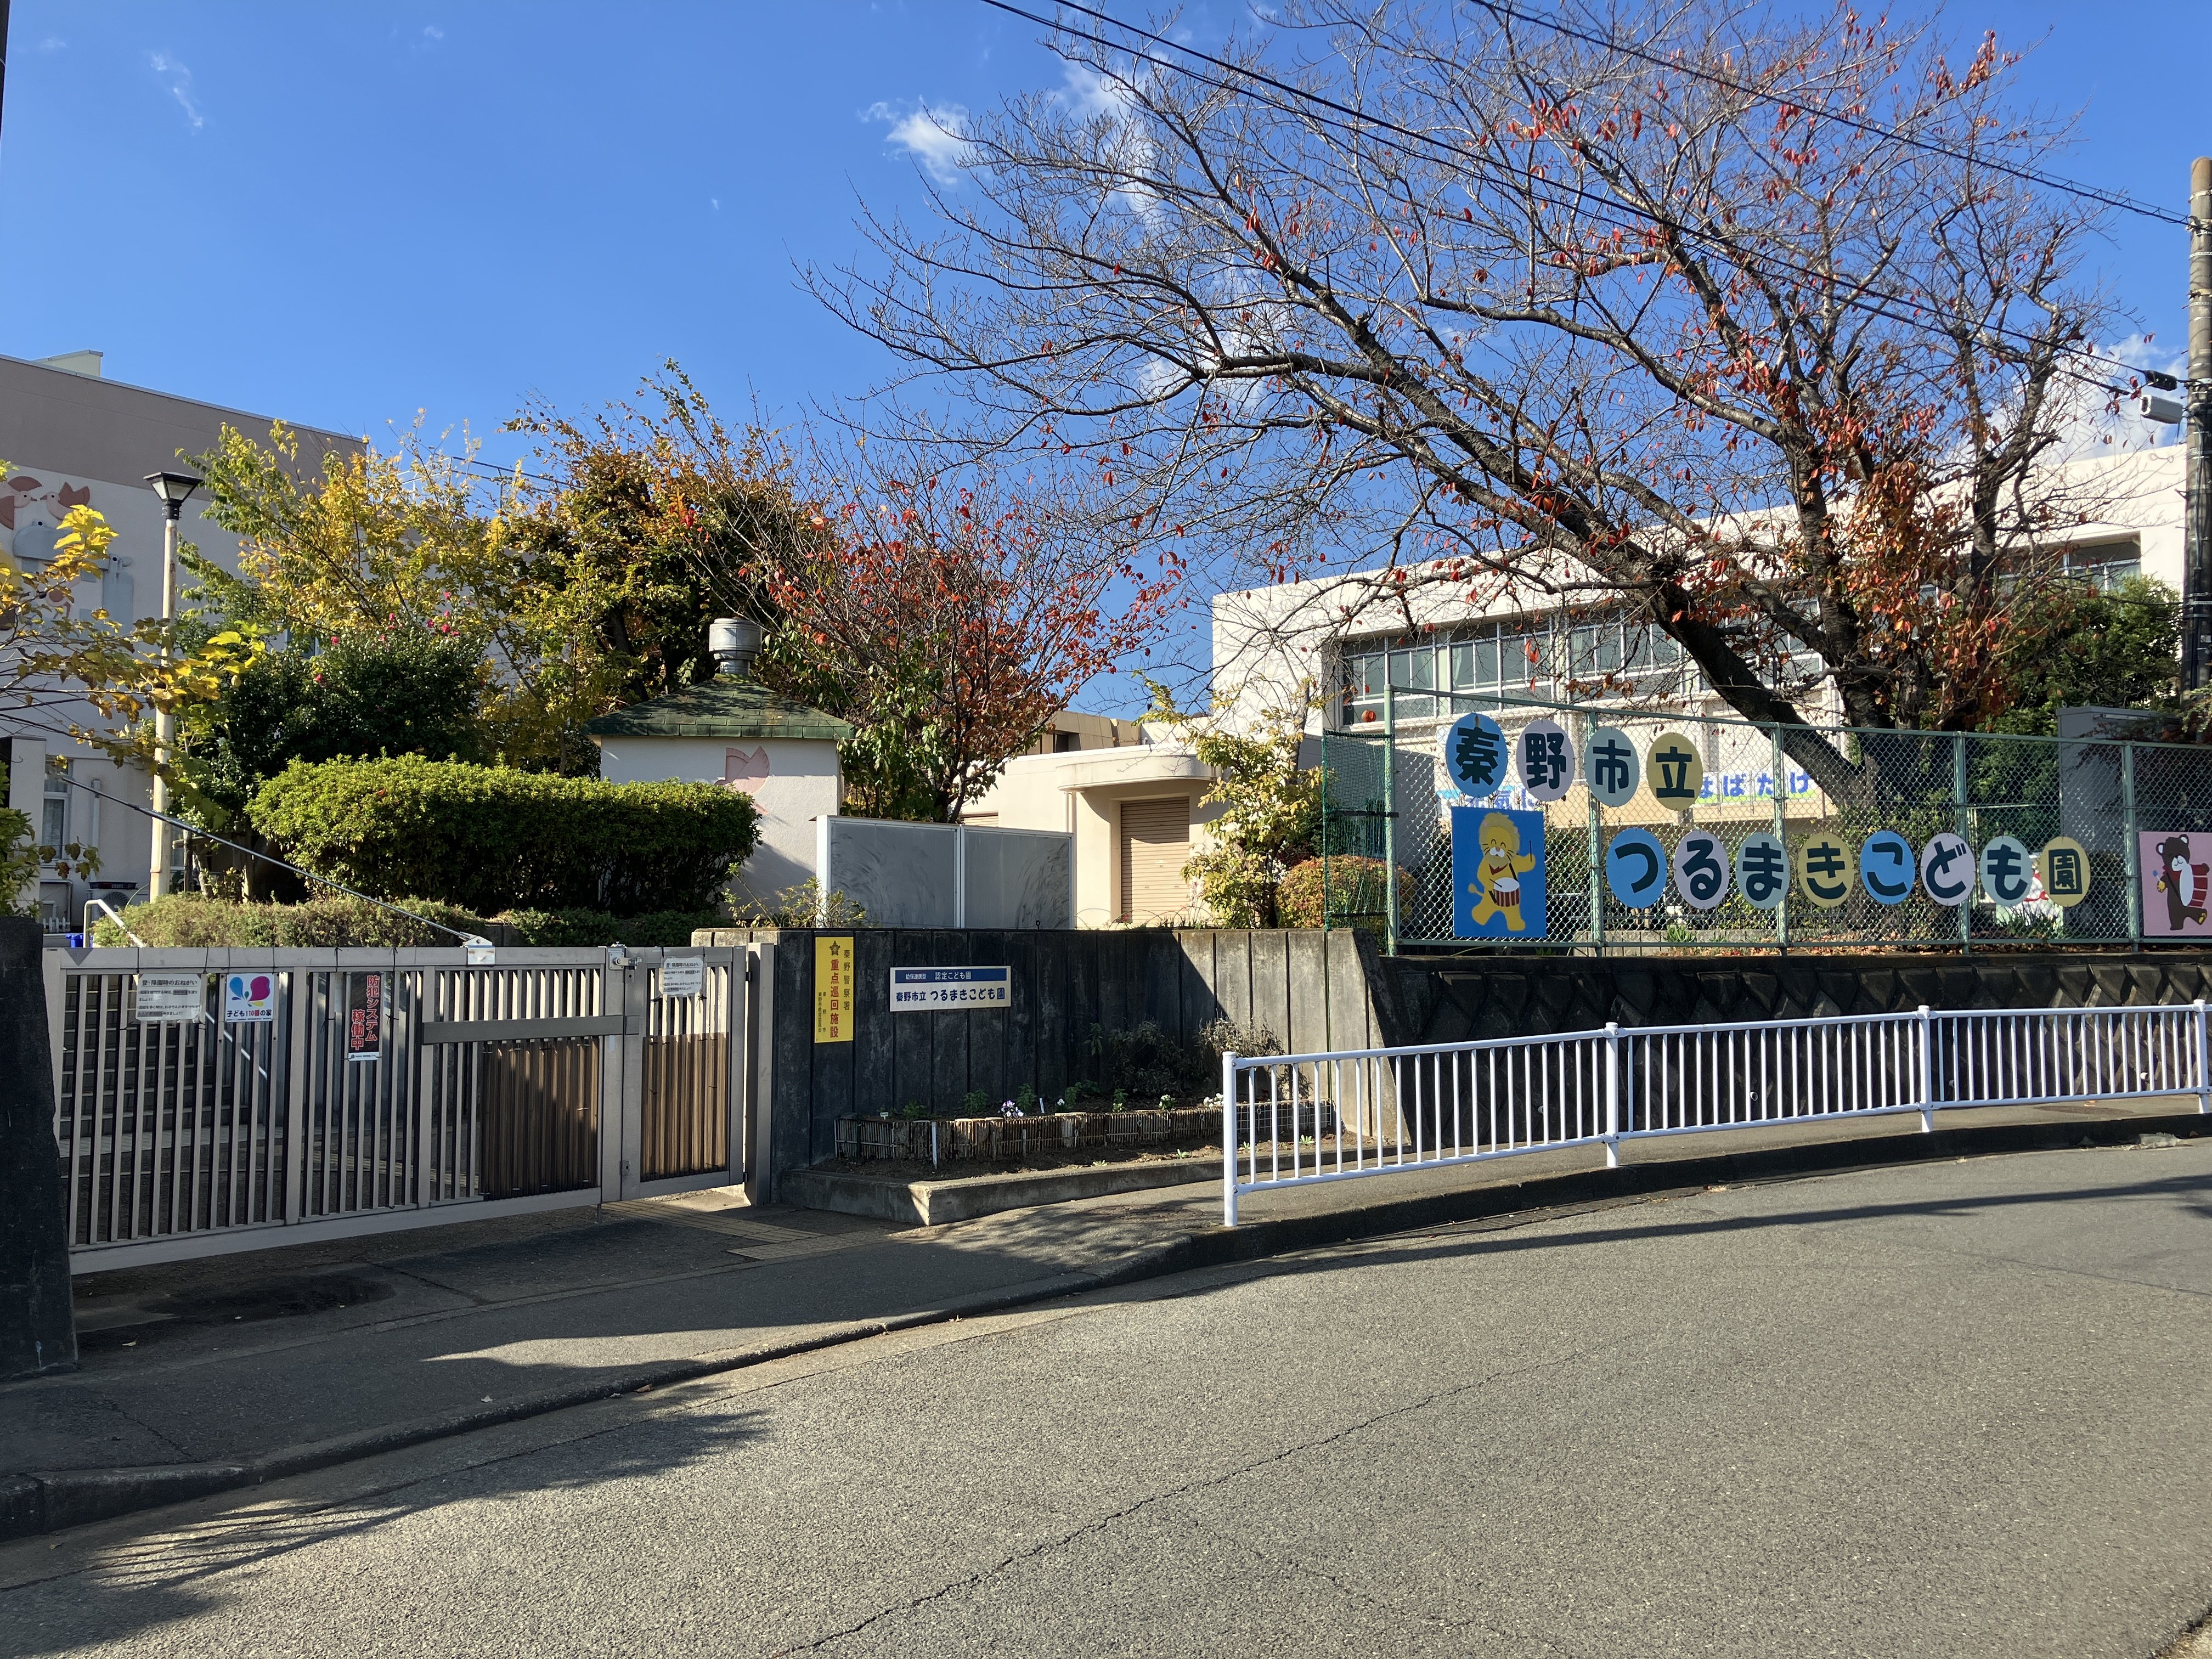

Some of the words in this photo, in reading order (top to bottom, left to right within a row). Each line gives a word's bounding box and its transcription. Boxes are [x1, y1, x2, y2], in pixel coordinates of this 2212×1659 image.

[1455, 725, 1695, 799] 秦野市立
[1615, 839, 2083, 901] つるまきこども園
[830, 959, 839, 1038] 重点巡回施設
[896, 991, 927, 1002] 秦野市立
[930, 988, 1005, 1001] つるまきこども園
[935, 971, 972, 980] 認定こども園
[227, 1009, 272, 1018] 子ども110番の家
[351, 1008, 365, 1051] 稼働中
[365, 975, 380, 1041] 防犯システム
